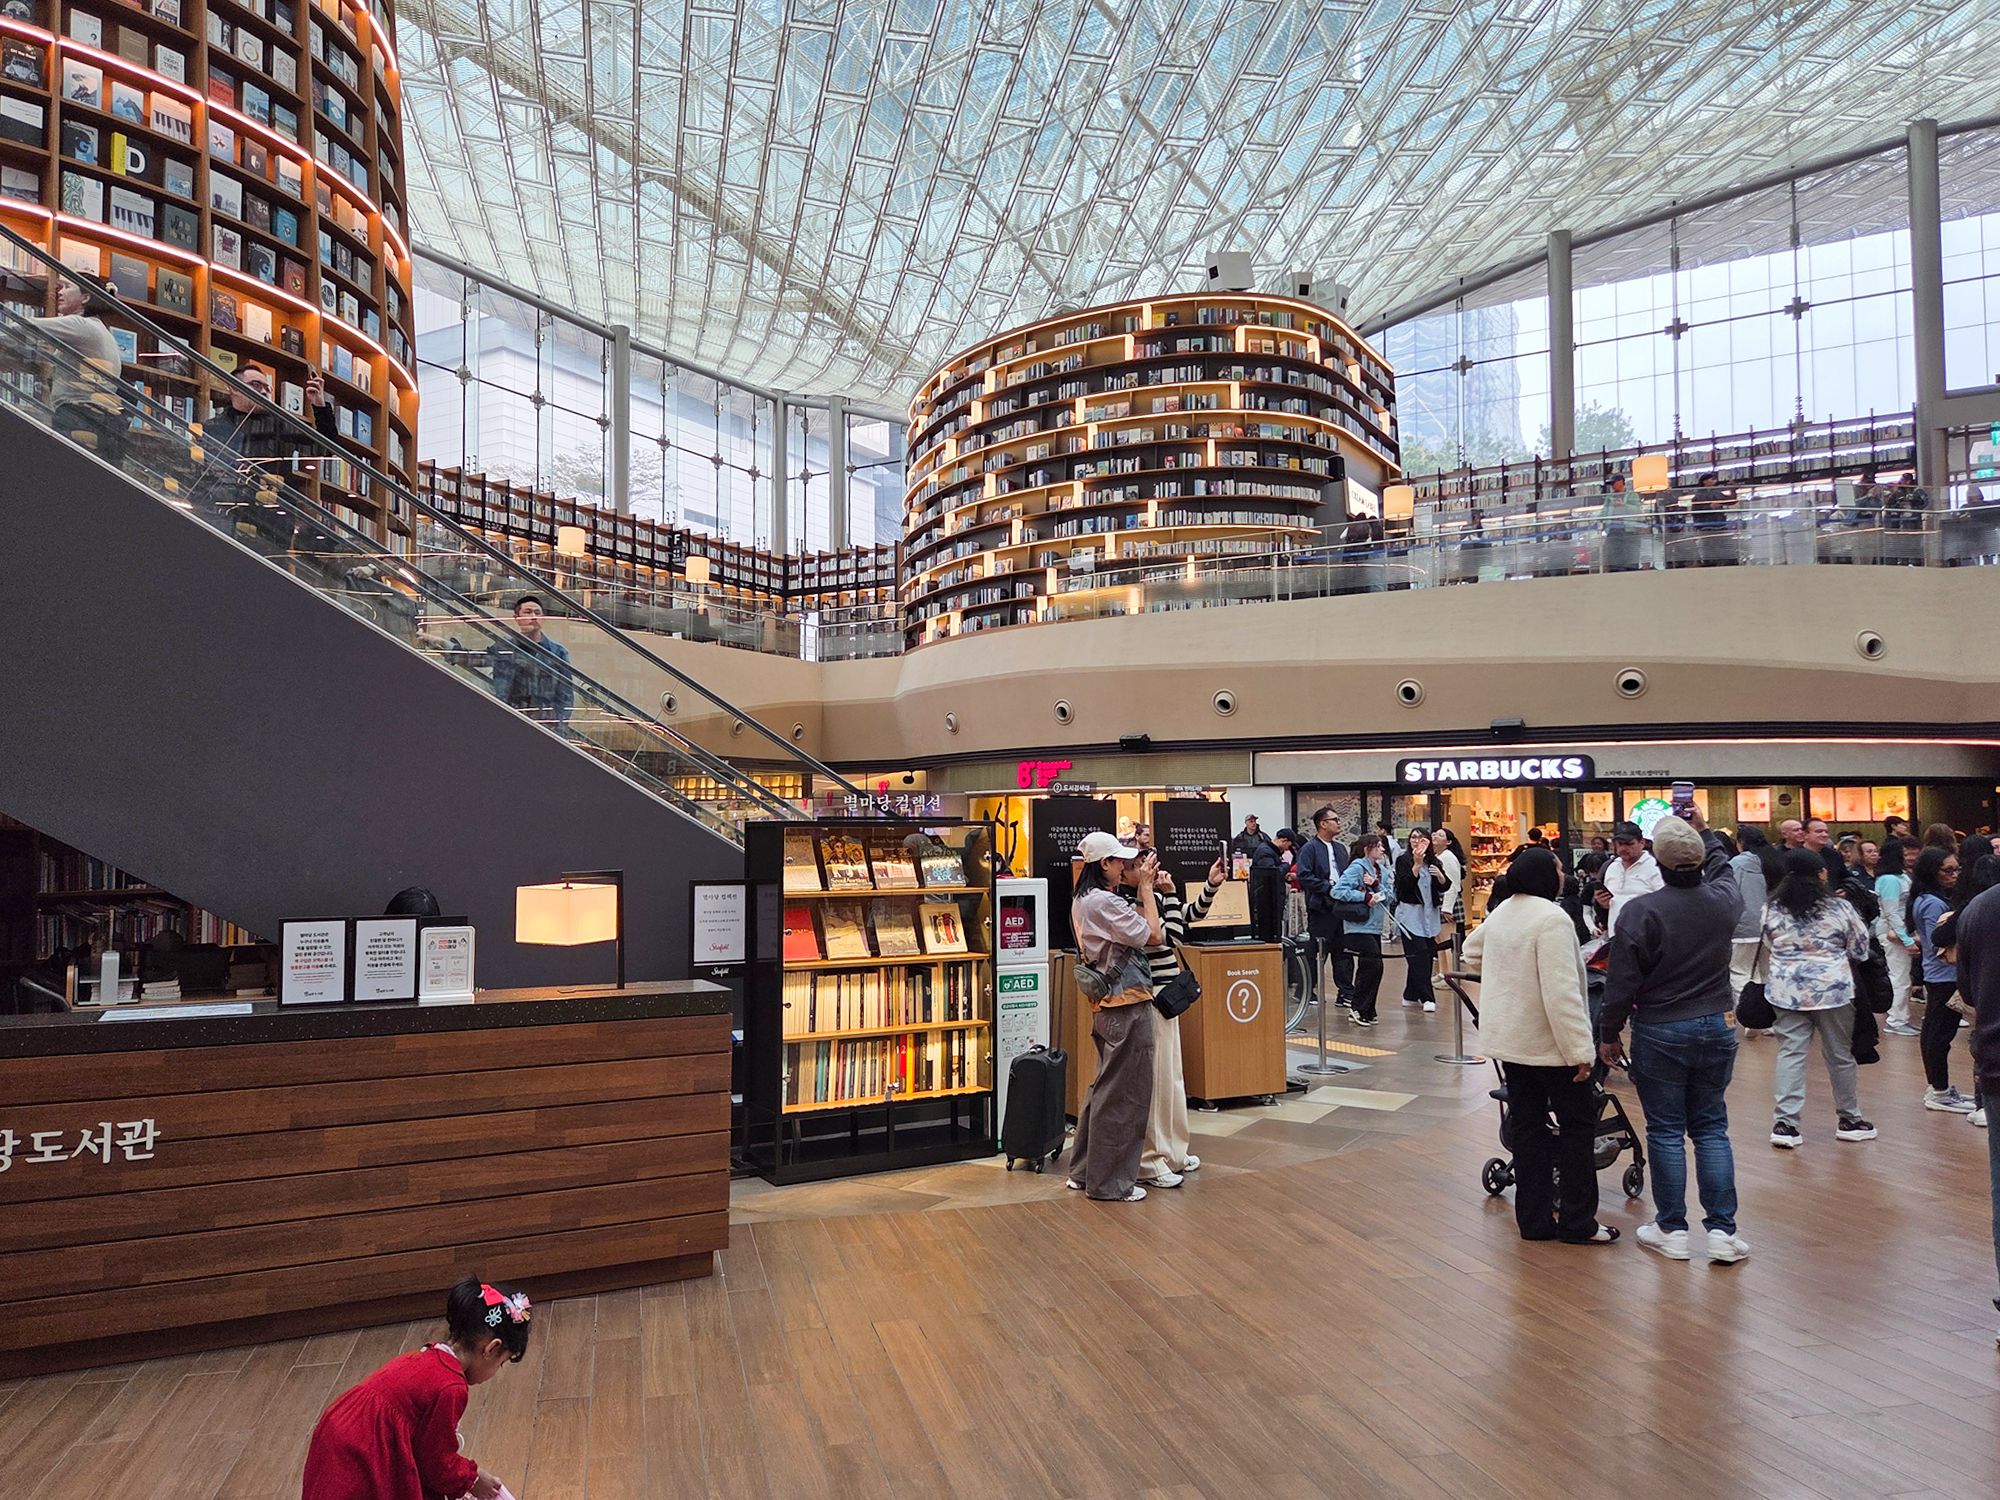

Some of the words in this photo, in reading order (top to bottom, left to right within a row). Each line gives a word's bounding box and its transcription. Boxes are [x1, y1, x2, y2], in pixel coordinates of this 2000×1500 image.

[674, 534, 681, 545] F
[1404, 758, 1584, 782] STARBUCKS
[843, 794, 891, 812] 별마당
[895, 794, 941, 812] 컬렉션
[703, 893, 719, 901] 별마당
[1004, 916, 1025, 926] AED
[1227, 969, 1241, 977] Book
[1242, 968, 1260, 976] Search
[1013, 978, 1035, 989] AED
[25, 1118, 162, 1164] 도서관
